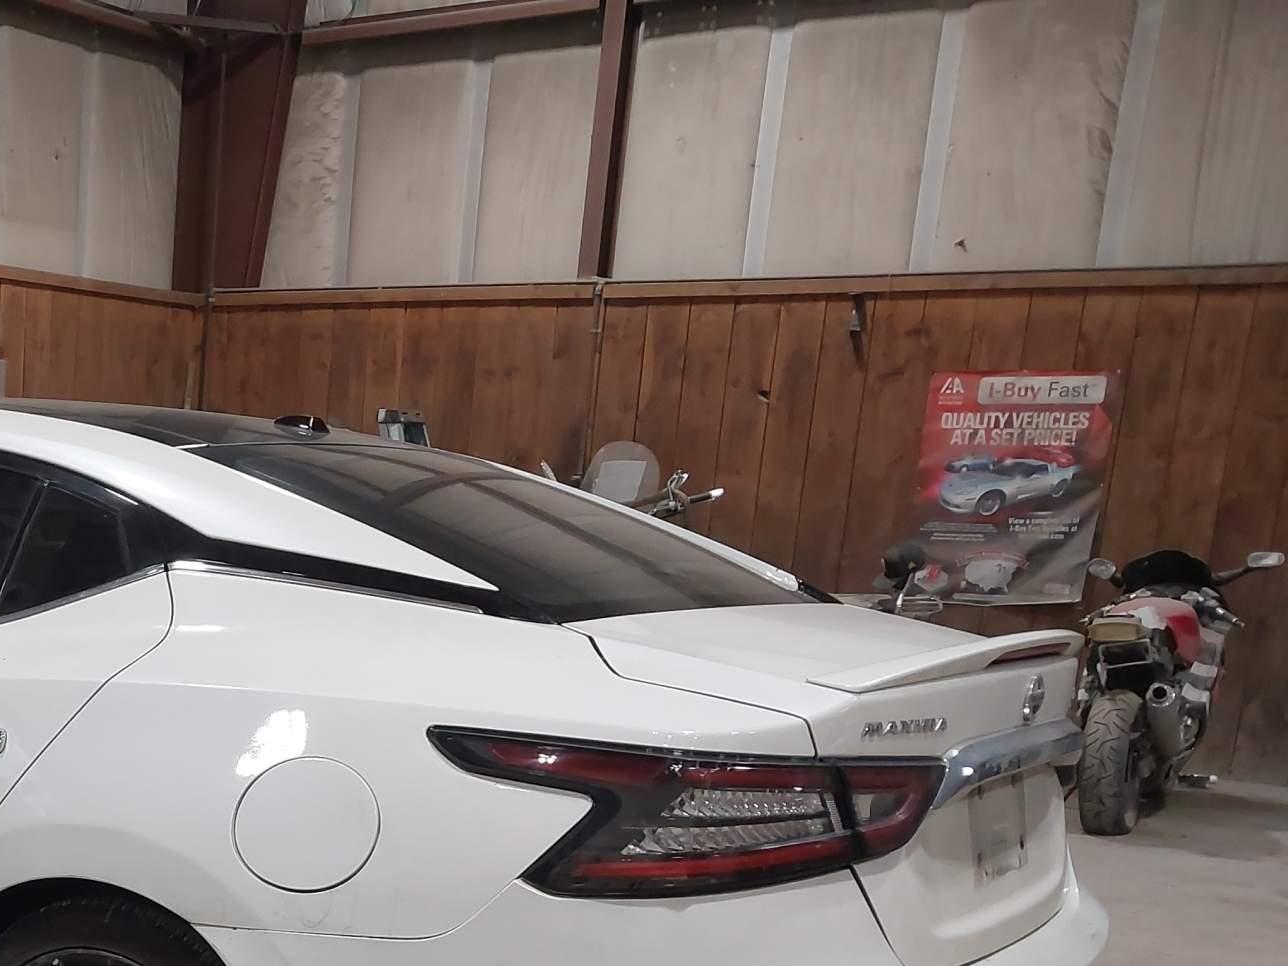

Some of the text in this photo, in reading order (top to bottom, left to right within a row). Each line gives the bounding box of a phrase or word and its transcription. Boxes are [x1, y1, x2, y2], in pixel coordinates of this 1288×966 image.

[989, 381, 1089, 400] I-Buy Fast
[941, 411, 1090, 429] QUALITY VEHICLES
[950, 428, 1078, 445] AT A SET PRICE!
